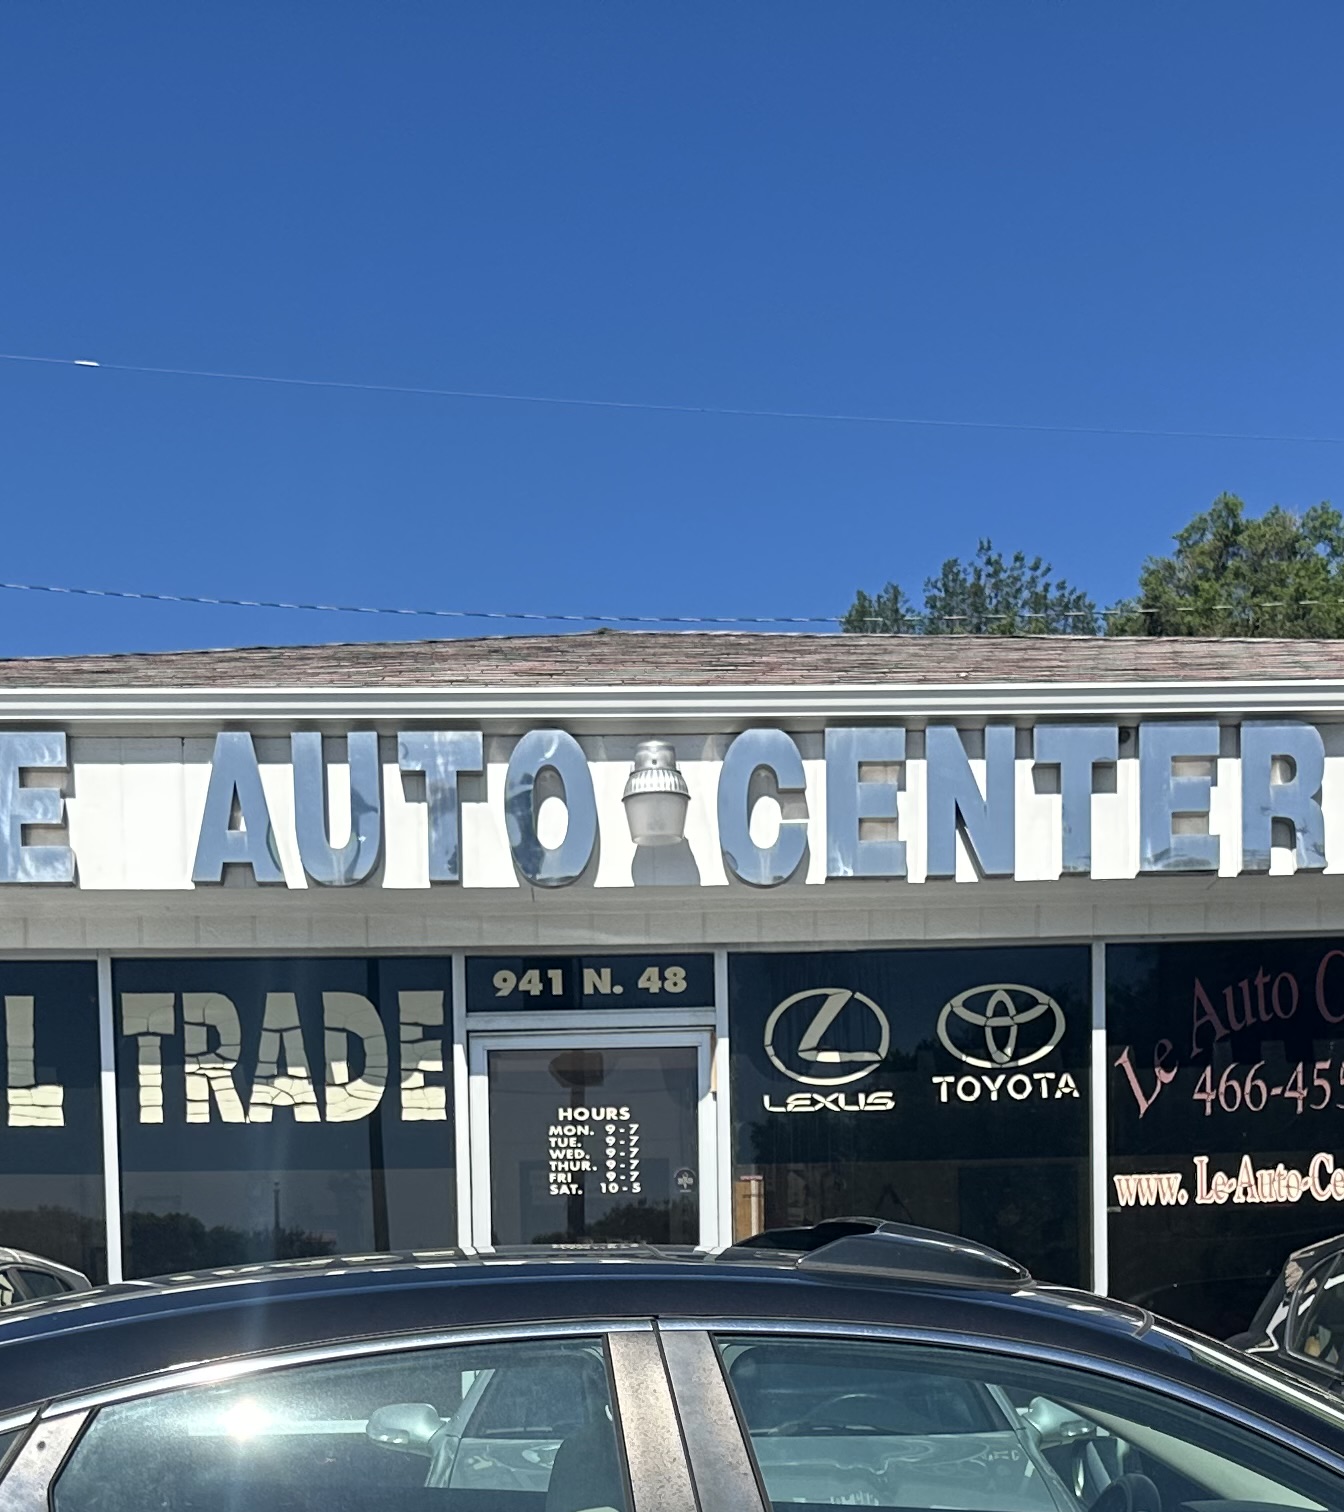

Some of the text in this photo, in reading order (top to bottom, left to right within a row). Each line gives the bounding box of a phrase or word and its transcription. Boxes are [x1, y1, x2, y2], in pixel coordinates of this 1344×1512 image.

[192, 729, 599, 887] AUTO
[717, 721, 1327, 887] CENTER
[493, 966, 688, 996] 941 N. 48
[1114, 1039, 1179, 1118] Le
[1190, 965, 1299, 1059] Auto
[121, 990, 447, 1124] TRADE
[932, 1072, 1080, 1102] TOYOTA
[763, 1091, 895, 1112] LEXUS
[558, 1107, 630, 1120] HOURS
[549, 1125, 594, 1136] MON.
[549, 1137, 582, 1148] TUE.
[549, 1149, 590, 1160] WED.
[549, 1160, 598, 1171] THUR.
[549, 1172, 572, 1183] FRI
[549, 1184, 583, 1195] SAT.
